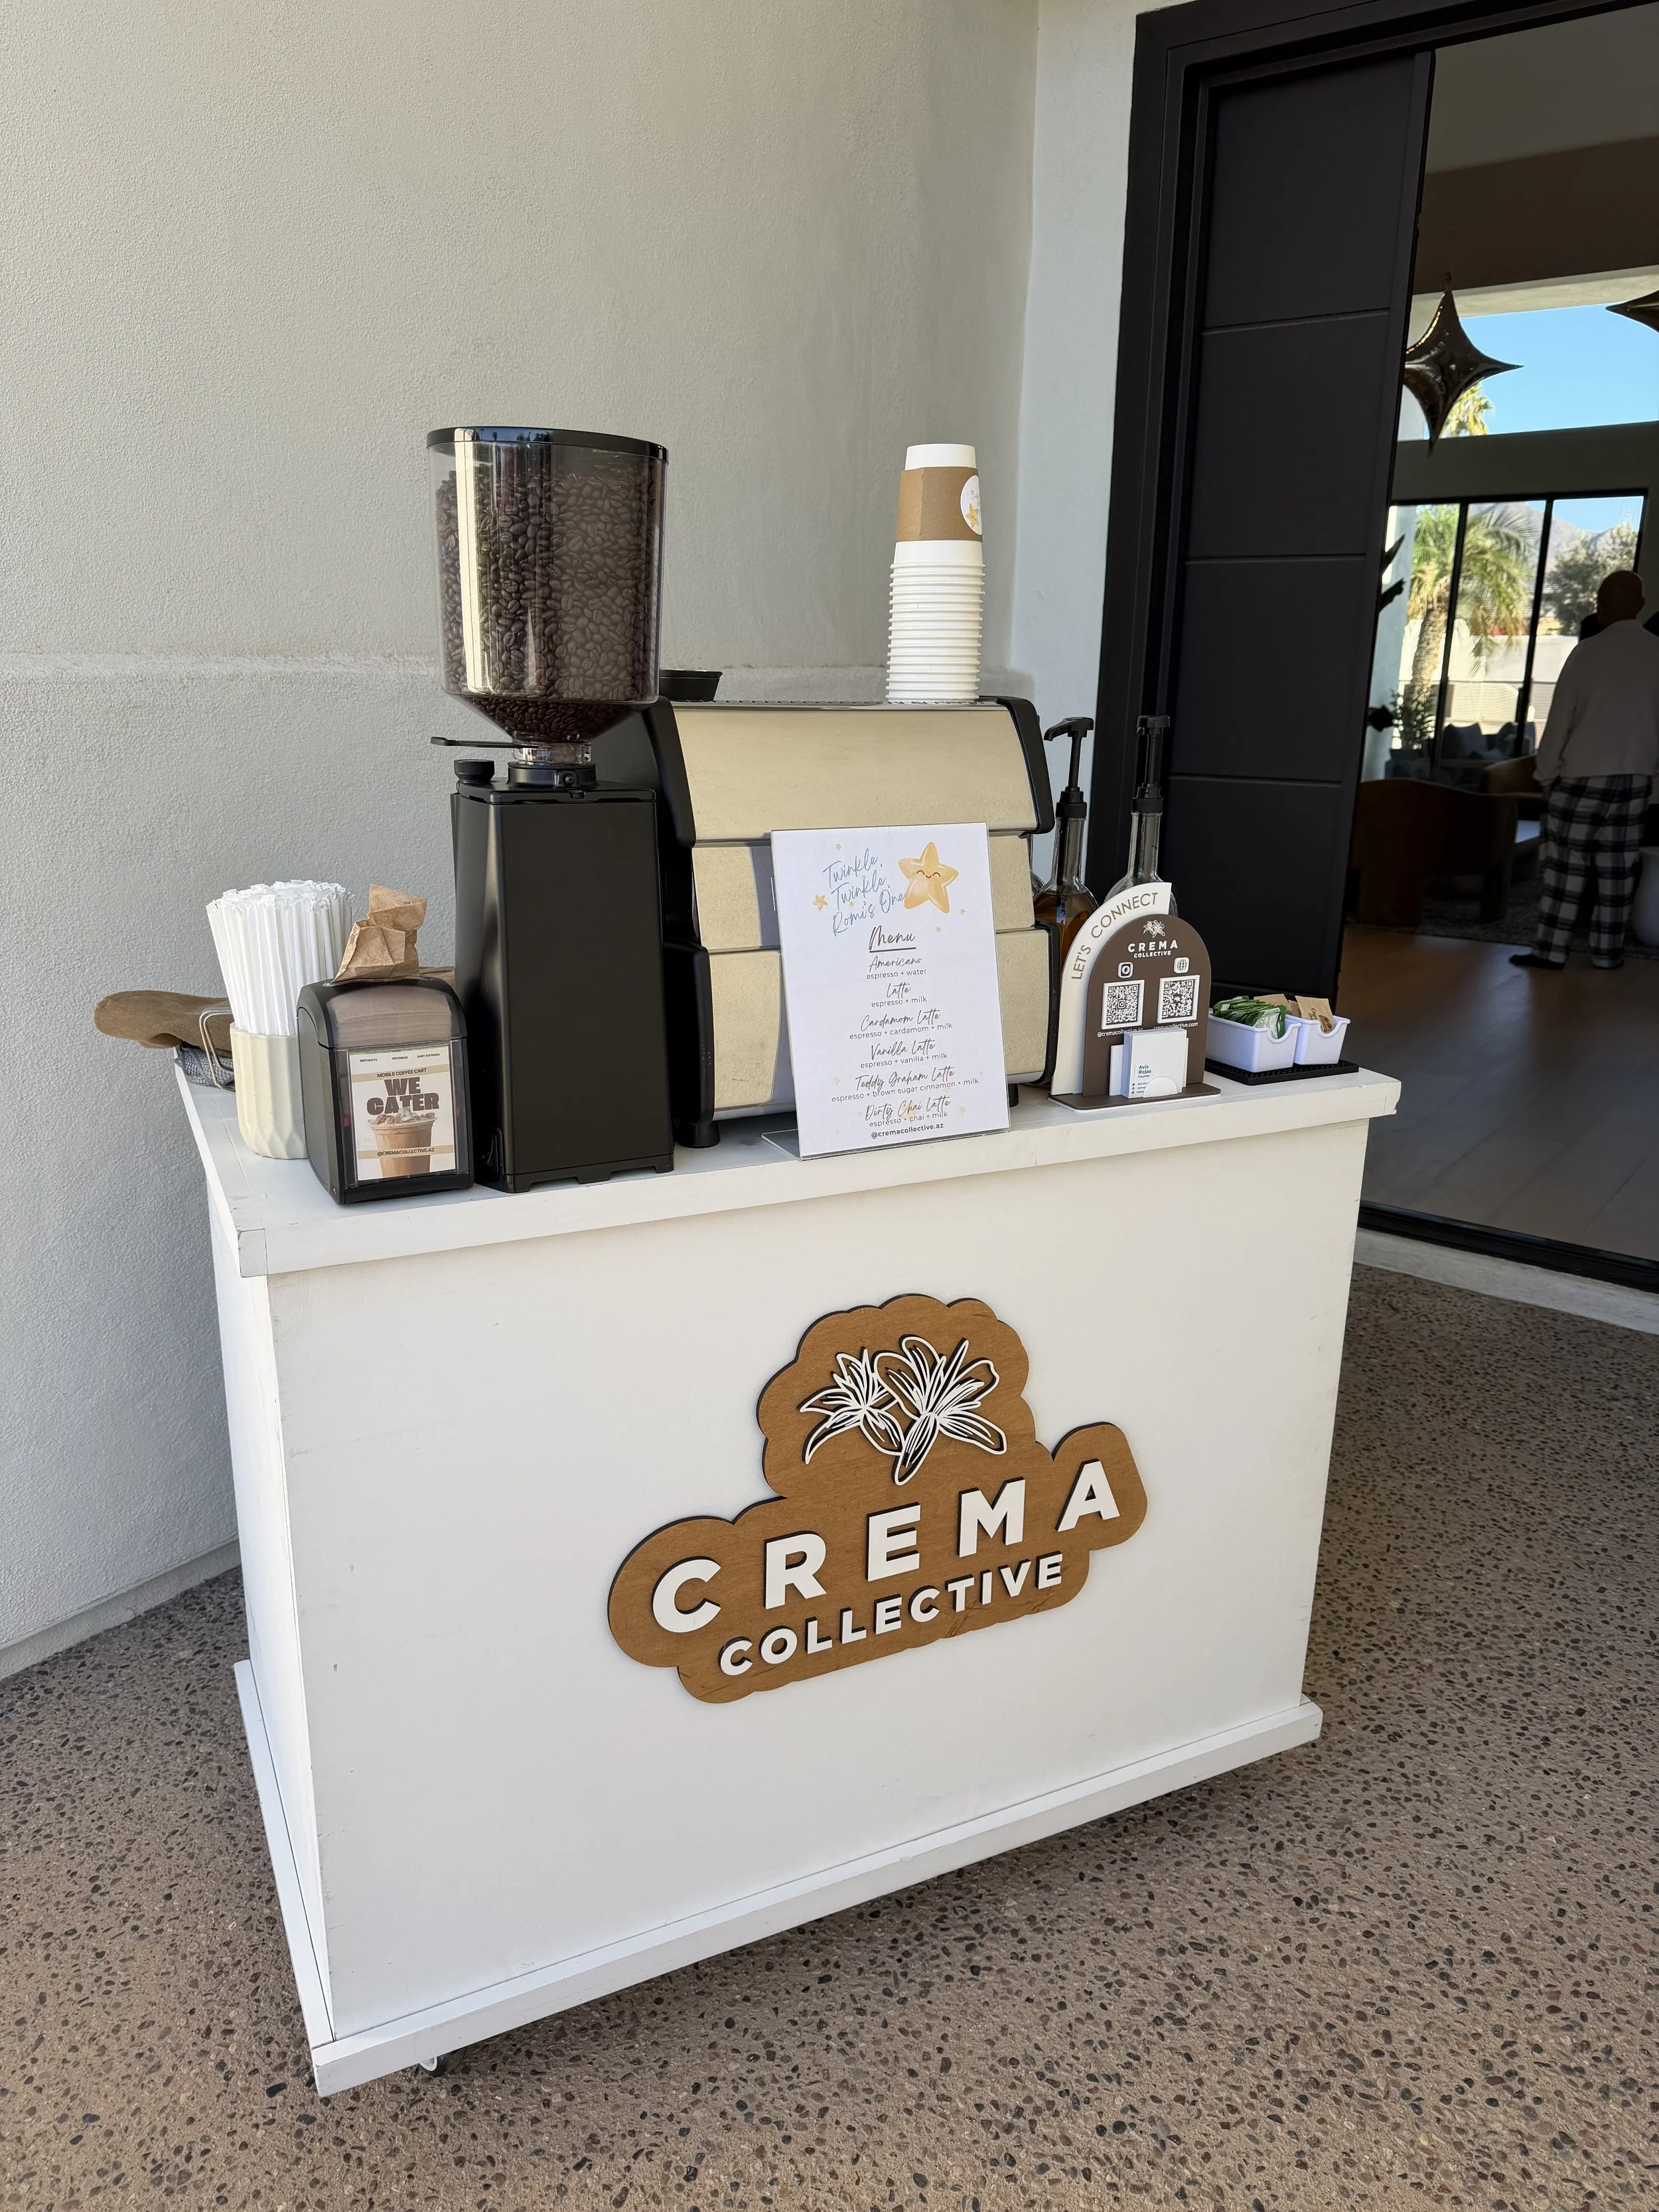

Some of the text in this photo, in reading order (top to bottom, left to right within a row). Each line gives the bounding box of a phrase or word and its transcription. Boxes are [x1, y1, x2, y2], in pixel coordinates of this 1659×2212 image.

[823, 848, 883, 889] Twinkle,
[831, 869, 890, 911] Twinkle,
[879, 889, 906, 913] One
[869, 925, 915, 950] Menu
[1072, 892, 1158, 980] LET'S CONNECT
[1128, 940, 1178, 952] CREMA
[869, 956, 922, 972] Americano
[887, 982, 910, 998] Latte
[861, 1009, 941, 1031] Cardamom Latte
[849, 1031, 882, 1040] espresso
[890, 1026, 928, 1035] cardamom
[1097, 1028, 1143, 1037] @cremacollctia
[871, 1038, 936, 1060] Vanilla Latte
[861, 1060, 892, 1069] espresso
[384, 1076, 421, 1096] WE
[855, 1065, 955, 1092] Teddy Graham Latte
[831, 1094, 864, 1102] espresso
[873, 1088, 896, 1097] brown
[920, 1082, 956, 1091] cinnamon
[366, 1092, 439, 1115] CATER
[865, 1095, 951, 1120] Dirty Chai Latte
[869, 1118, 901, 1127] espresso
[871, 1124, 944, 1139] @cremacollective.az
[377, 1147, 435, 1156] @CREMACOLLECTIVE.AZ
[652, 1459, 1120, 1633] CREMA
[719, 1551, 1063, 1676] COLLECTIVE
